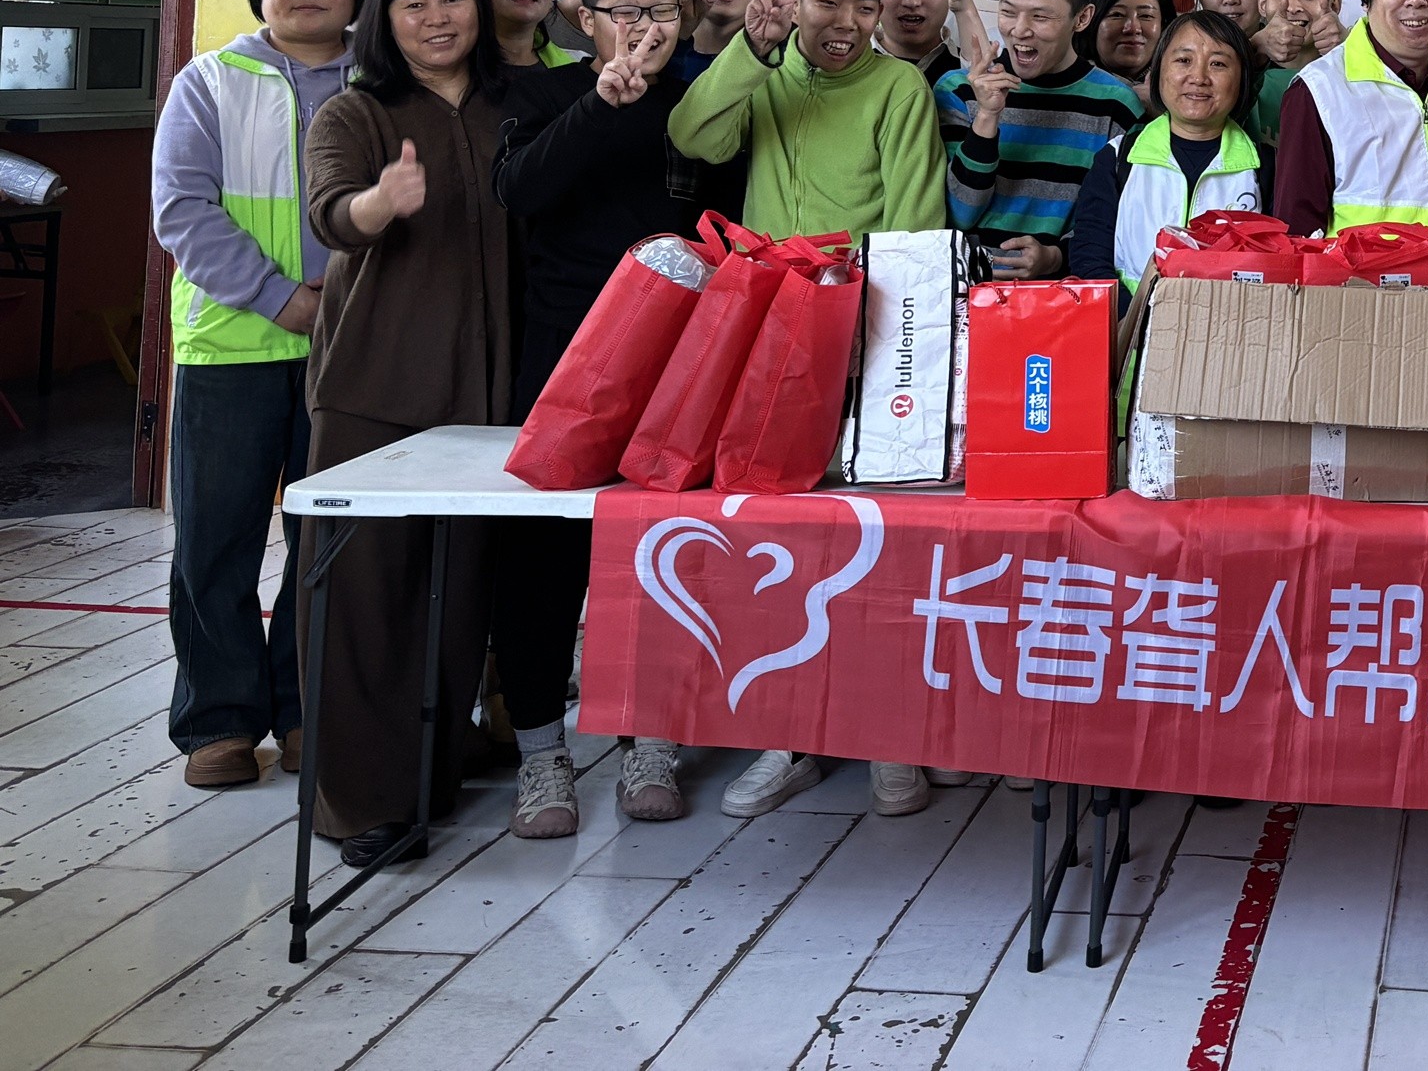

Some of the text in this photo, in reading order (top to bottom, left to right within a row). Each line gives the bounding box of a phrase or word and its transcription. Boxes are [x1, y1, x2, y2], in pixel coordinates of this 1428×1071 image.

[895, 297, 915, 388] lululemon
[1028, 361, 1048, 426] 六个核桃
